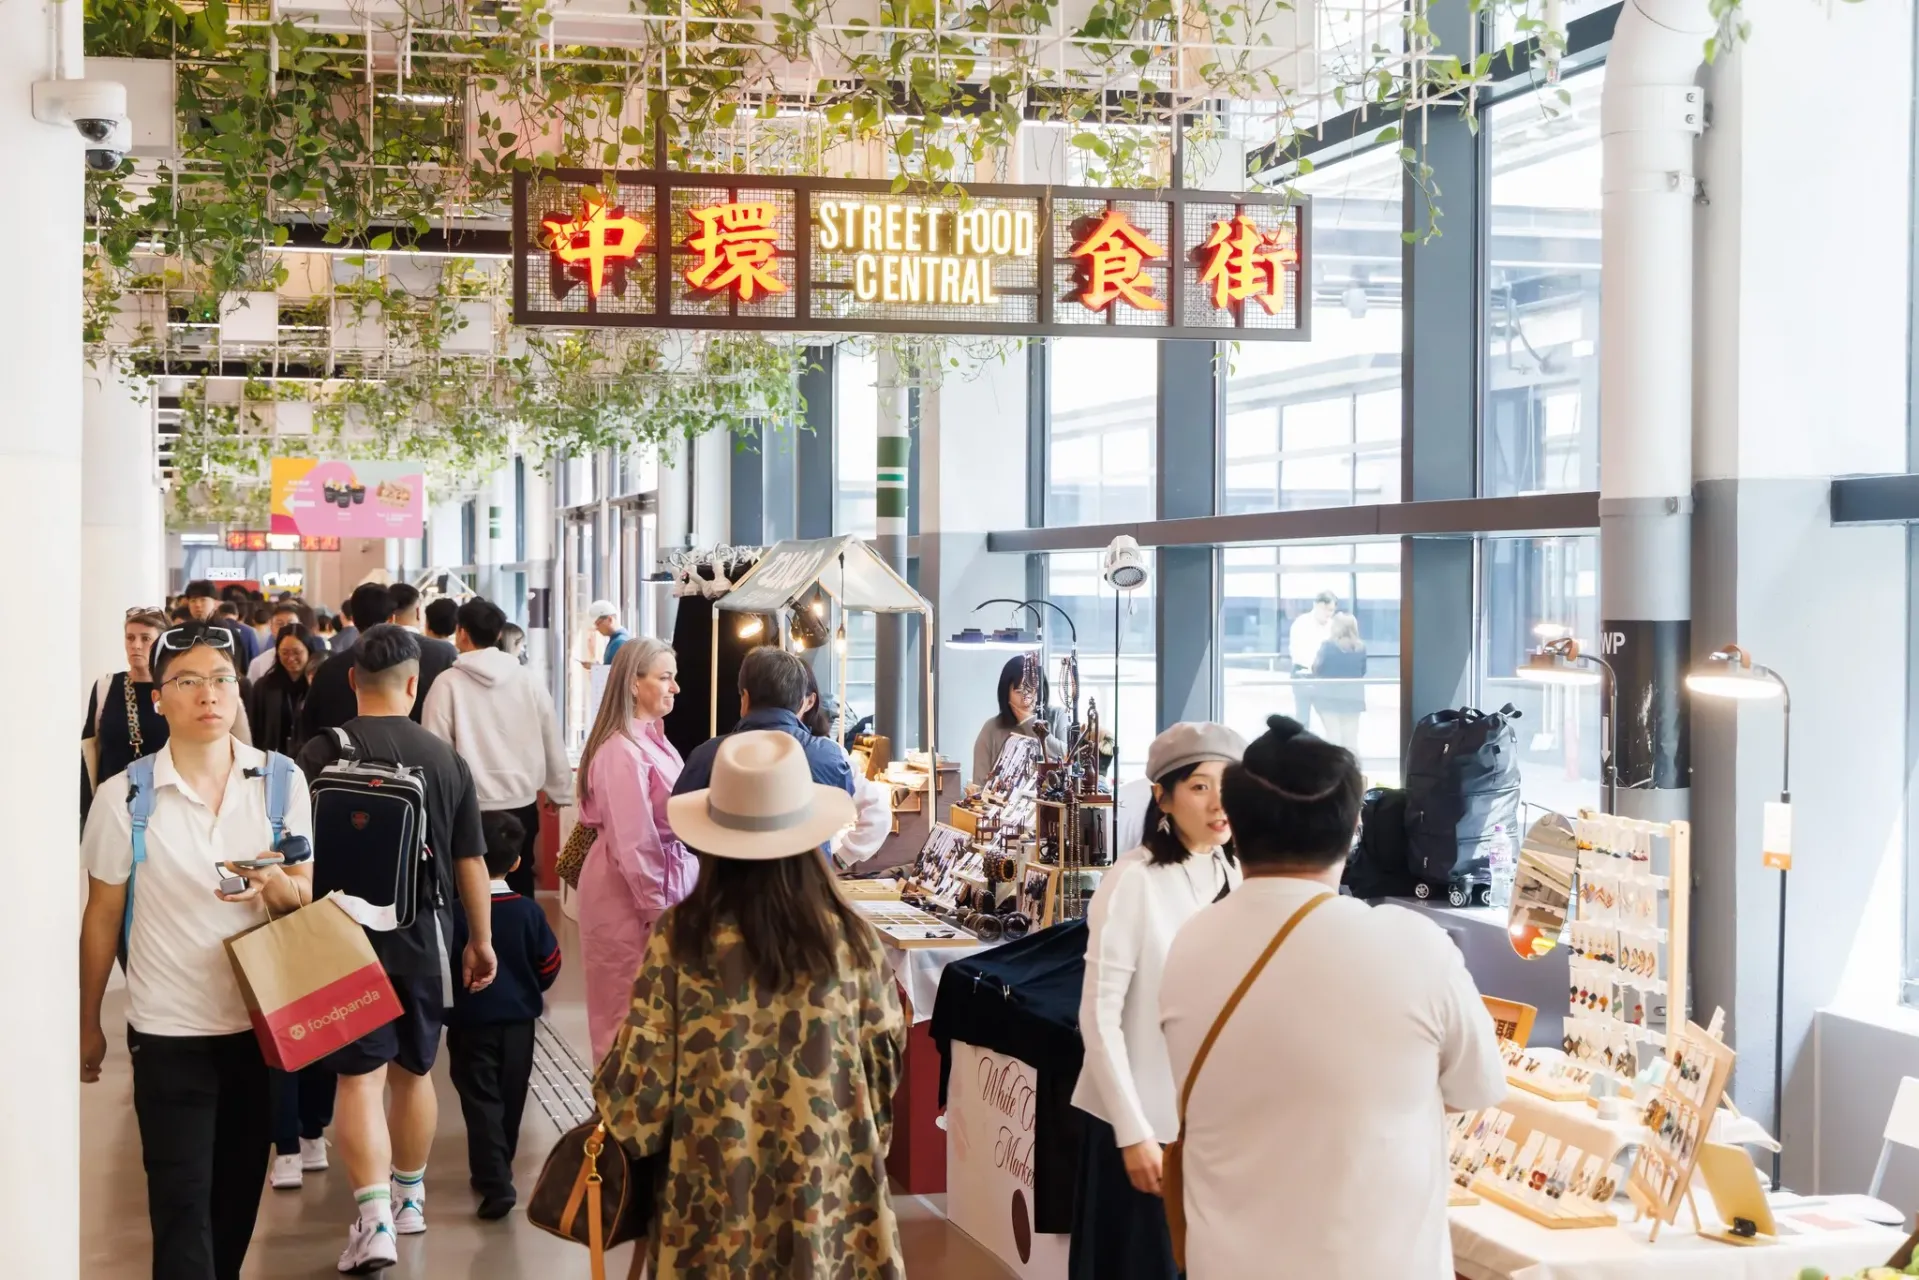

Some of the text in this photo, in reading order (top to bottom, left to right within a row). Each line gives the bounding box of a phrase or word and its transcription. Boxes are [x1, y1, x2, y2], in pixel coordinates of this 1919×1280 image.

[543, 196, 790, 301] 中環
[818, 199, 1034, 257] STREET FOOD
[855, 253, 999, 304] CENTRAL
[1072, 211, 1297, 315] 食街
[307, 990, 381, 1033] foodpanda
[978, 1056, 1026, 1118] White
